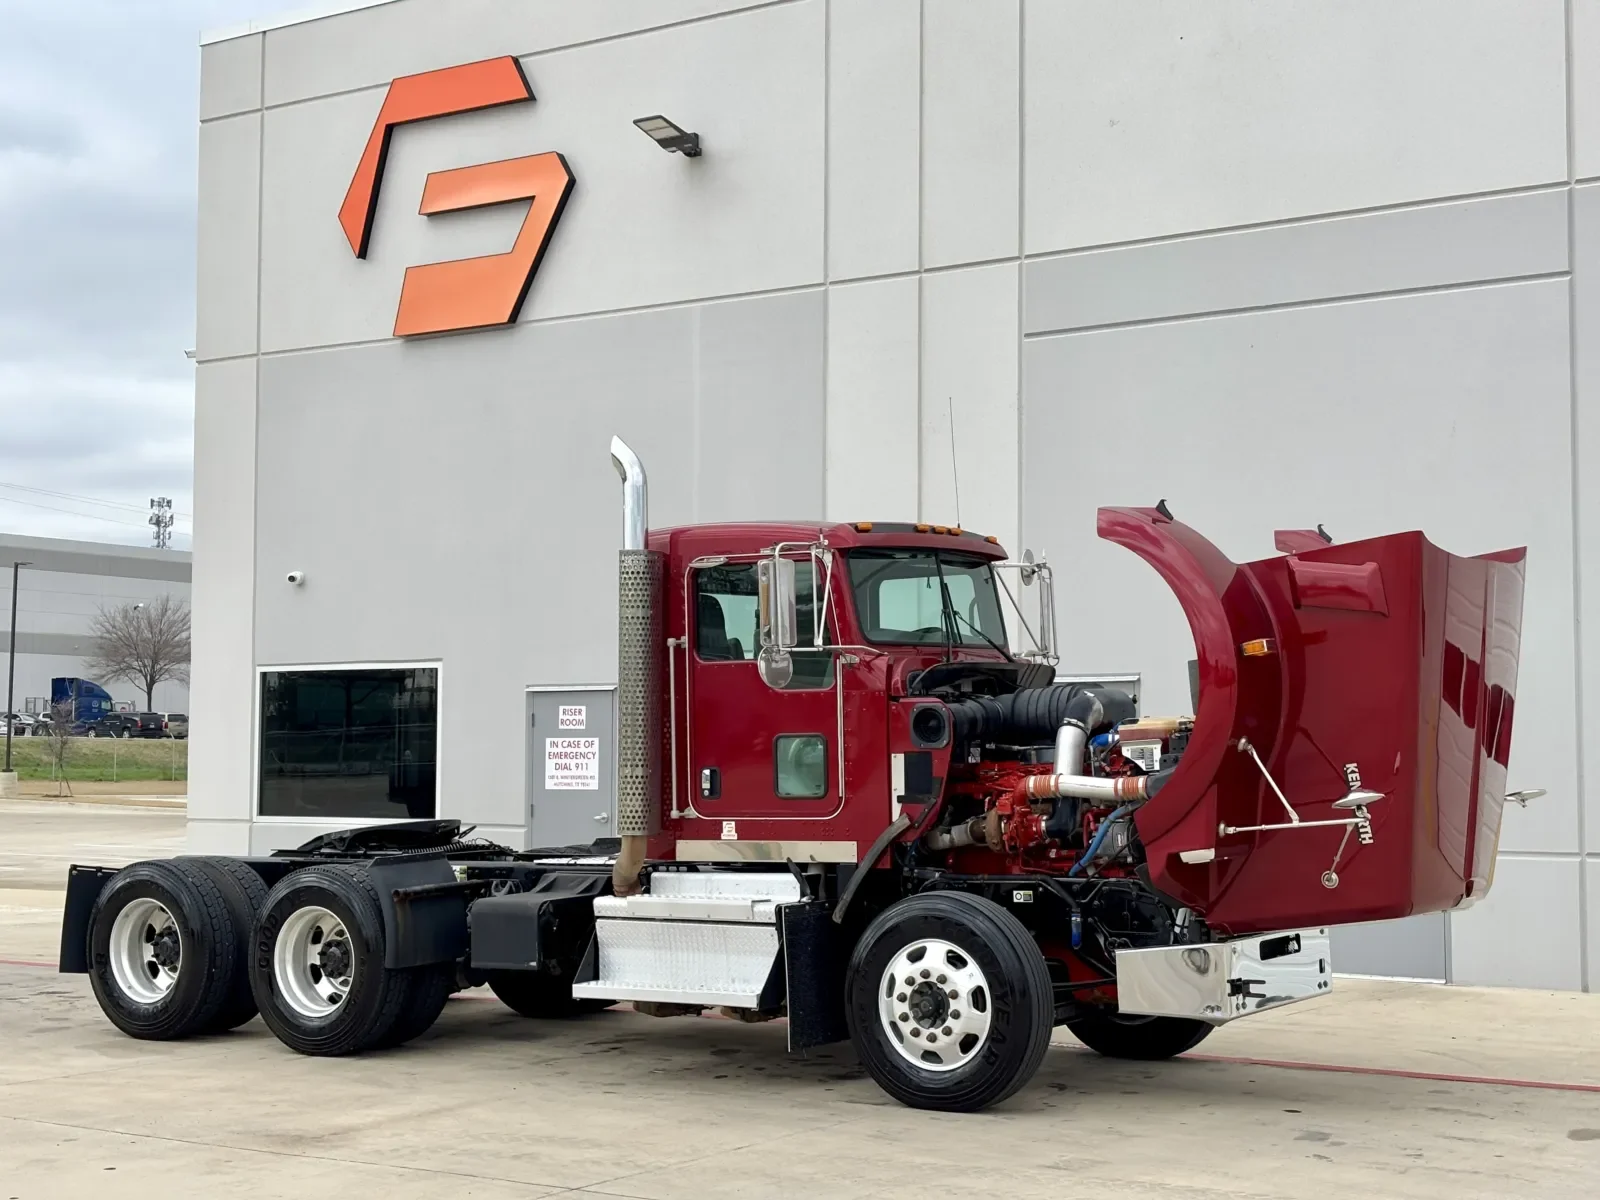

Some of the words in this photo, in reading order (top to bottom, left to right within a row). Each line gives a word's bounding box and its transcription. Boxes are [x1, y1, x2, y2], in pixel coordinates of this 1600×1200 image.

[562, 708, 583, 717] RISER
[560, 718, 585, 727] ROOM
[549, 740, 559, 749] IN
[561, 740, 582, 749] CASE
[583, 740, 595, 749] OF
[548, 751, 597, 760] EMERGENCY
[554, 762, 573, 771] DIAL
[575, 762, 589, 771] 911
[1345, 762, 1374, 845] KENORTH
